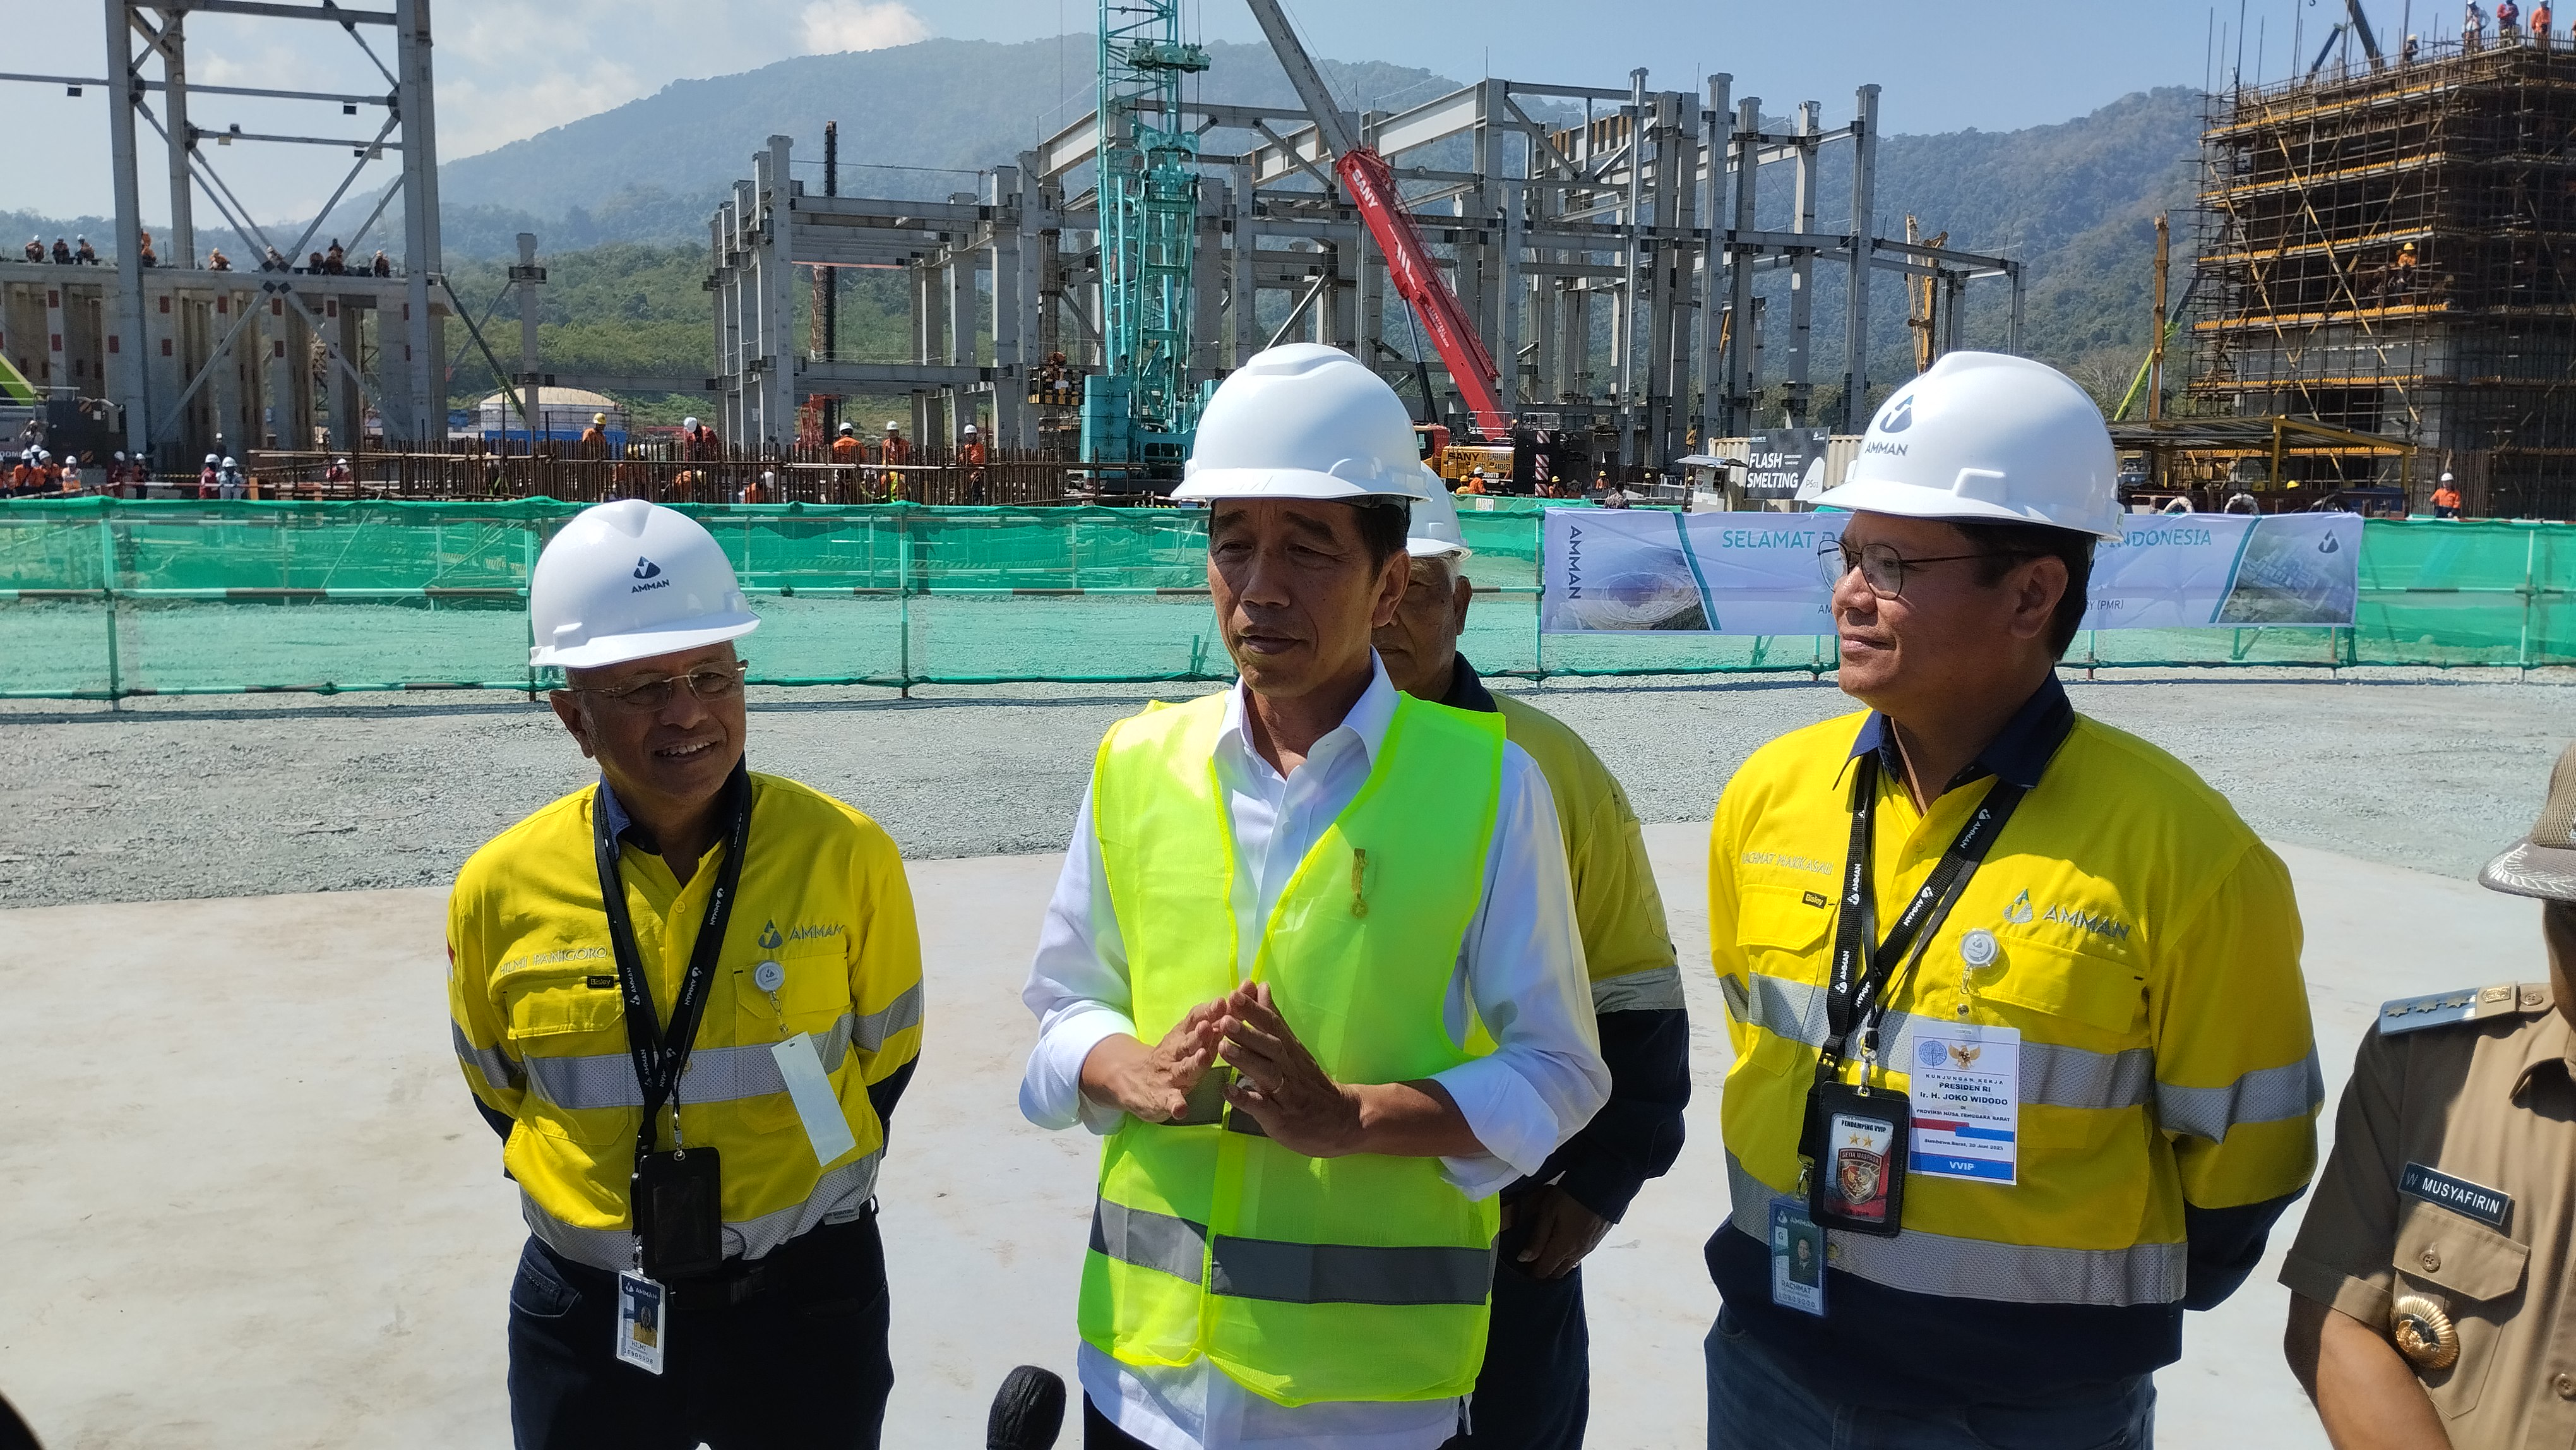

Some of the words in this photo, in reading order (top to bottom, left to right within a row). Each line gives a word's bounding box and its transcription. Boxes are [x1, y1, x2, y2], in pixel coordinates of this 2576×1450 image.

[1352, 169, 1379, 208] SANY
[1448, 452, 1479, 462] SANY
[1864, 441, 1908, 456] AMMAN
[1749, 452, 1783, 469] FLASH
[1746, 472, 1799, 489] SMELTING
[1722, 530, 1815, 549] SELAMAT
[2109, 529, 2212, 548] NDONESIA
[1568, 525, 1583, 599] AMMAN
[631, 579, 670, 593] AMMAN
[2097, 599, 2124, 610] (PMR)
[1960, 821, 1981, 849] AMMAN
[1852, 863, 1861, 892] AMMAN
[1805, 894, 1824, 906] Bisley
[709, 900, 722, 926] AMMAN
[1903, 898, 1924, 926] AMMAN
[2042, 904, 2131, 941] AMMAN
[790, 924, 845, 940] AMMAN
[499, 956, 528, 976] HILMI
[533, 946, 607, 966] PANIGORO
[1840, 950, 1850, 980] AMMAN
[626, 967, 638, 993] AMMAN
[684, 979, 697, 1005] AMMAN
[640, 1049, 650, 1075] AMMAN
[1939, 1082, 1980, 1091] PRESIDEN
[1943, 1093, 1968, 1101] JOKO
[1971, 1096, 2008, 1105] WIDODO
[1841, 1120, 1873, 1131] PENDAMPING
[1856, 1153, 1879, 1164] WASPADA
[1949, 1161, 1975, 1171] VVIP
[2421, 1177, 2500, 1214] MUSYAFIRIN
[1778, 1231, 1784, 1240] G
[635, 1287, 657, 1300] AMMAN
[1782, 1280, 1811, 1295] RACHMAT
[631, 1341, 647, 1351] HILMI
